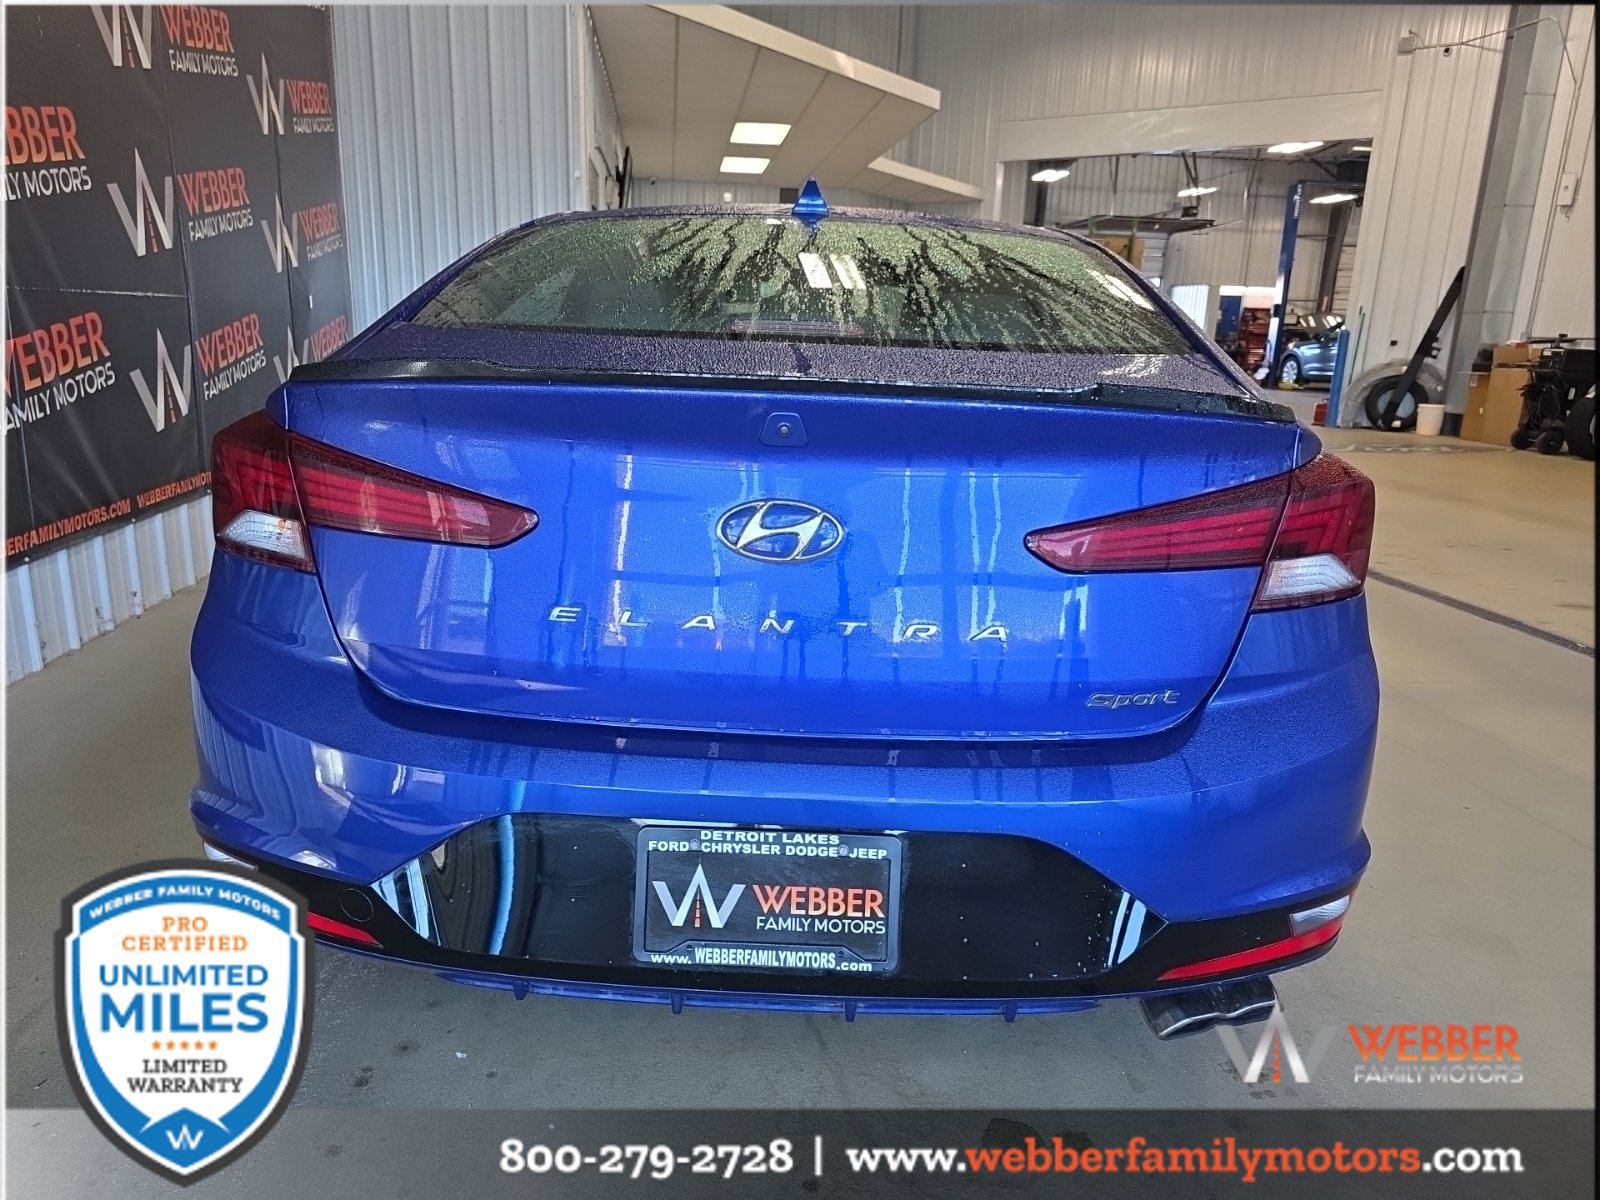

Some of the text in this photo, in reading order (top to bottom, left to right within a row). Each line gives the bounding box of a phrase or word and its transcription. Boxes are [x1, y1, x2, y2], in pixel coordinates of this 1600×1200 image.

[160, 5, 236, 53] WEBBER
[168, 49, 239, 77] FAMILY MOTORS
[286, 79, 332, 114] WEBBER
[5, 105, 86, 165] BBER
[23, 165, 92, 198] MOTORS
[177, 167, 250, 217] WEBBER
[188, 208, 254, 242] FAMILY MOTORS
[299, 202, 341, 242] WEBBER
[195, 313, 264, 377] WEBBER
[310, 315, 348, 363] WEBBER
[203, 349, 267, 401] FAMILY MOTORS
[5, 362, 116, 435] AMILY MOTORS
[5, 499, 131, 557] ERFAMILYMOTORS.COM
[548, 606, 1010, 643] ELANTRA
[1085, 688, 1181, 710] Sport
[648, 840, 888, 860] FORD CHRYSLER DODGE JEEP
[700, 830, 840, 845] DETROIT LAKES
[752, 884, 885, 918] WEBBER
[756, 916, 886, 934] FAMILY MOTORS
